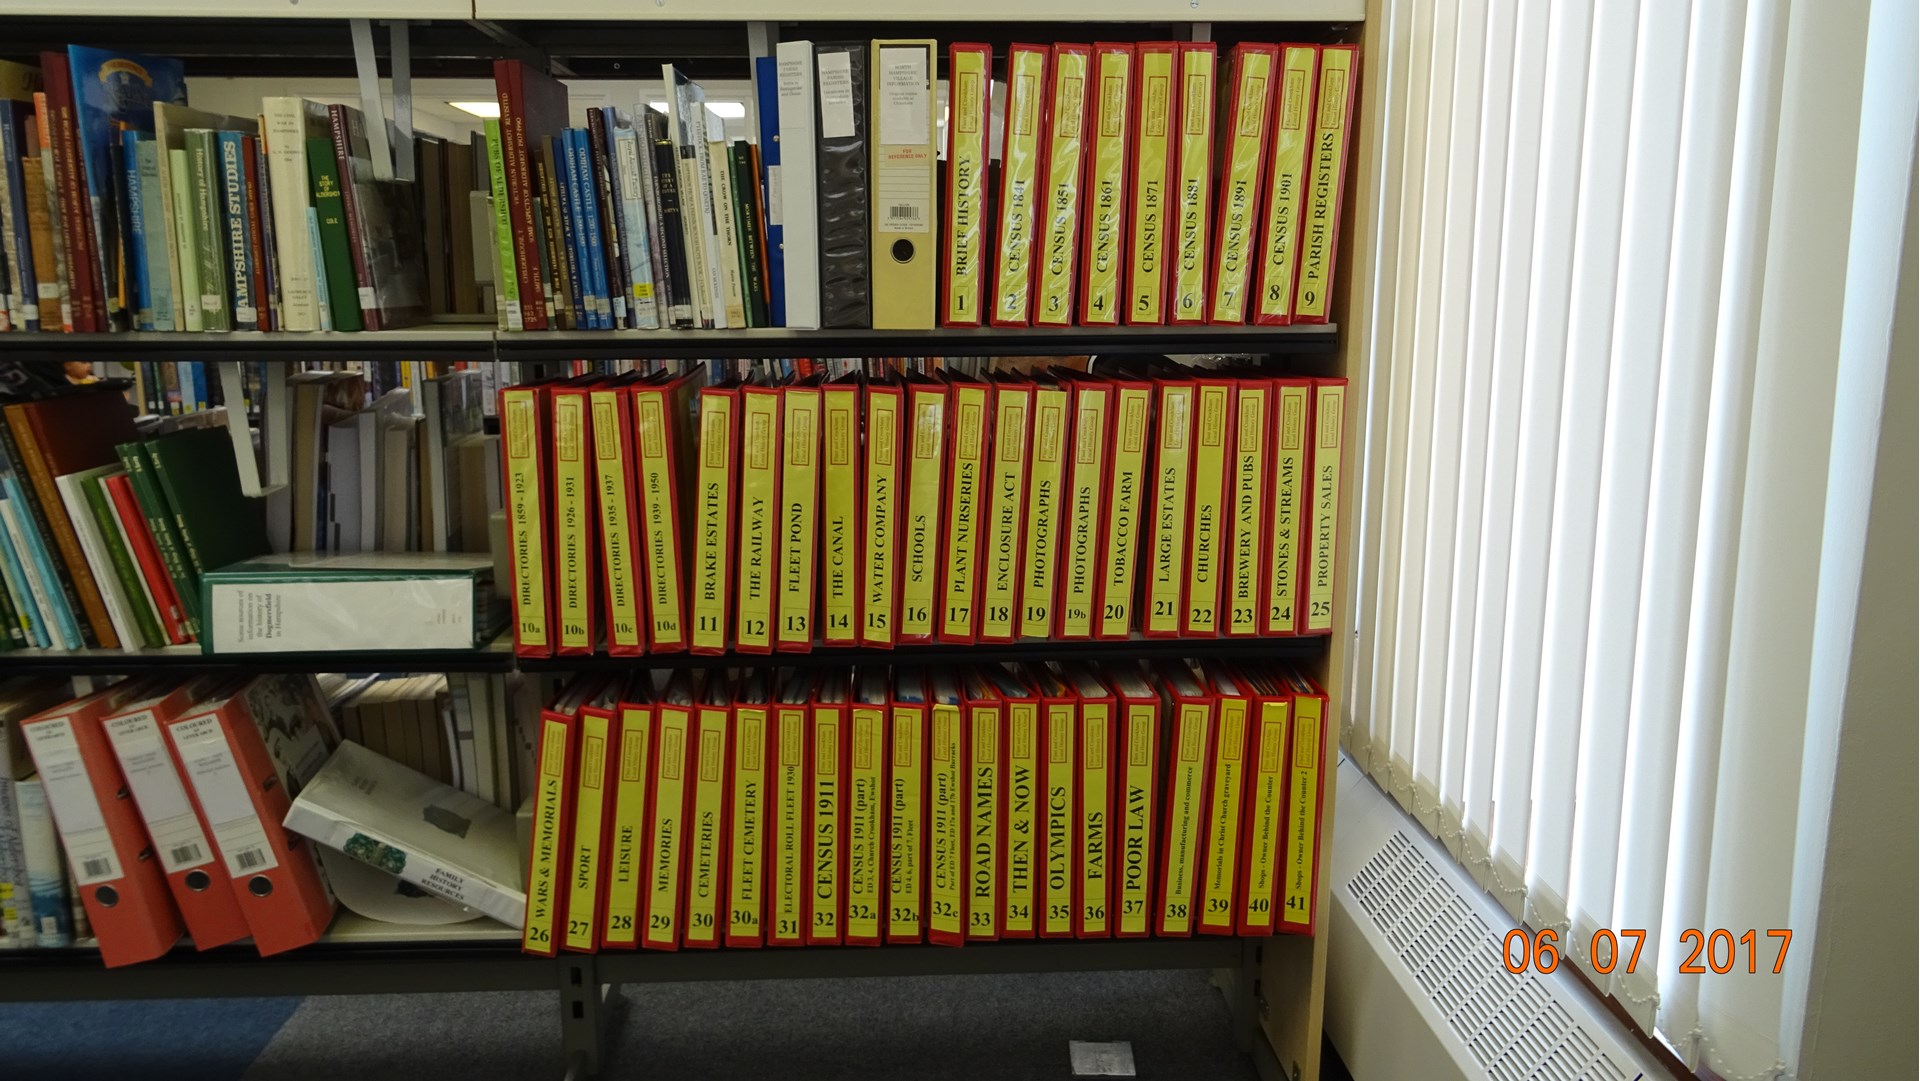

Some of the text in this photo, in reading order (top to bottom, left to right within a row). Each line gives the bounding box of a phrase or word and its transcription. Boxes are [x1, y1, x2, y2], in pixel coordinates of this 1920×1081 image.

[195, 148, 205, 177] History
[331, 110, 345, 160] HAMPSHIRE
[491, 139, 500, 160] PUBS
[494, 162, 502, 173] OF
[502, 93, 520, 205] VICTORIAN ALDERSHOT REVISITED
[518, 150, 529, 187] ALDERSHOT
[127, 170, 142, 235] HAMPSHIRE
[197, 189, 209, 231] Hampshire
[319, 179, 334, 187] STORY
[523, 198, 533, 225] ASPECTS
[579, 148, 597, 247] ODIHAM CASTLE 1200-1500
[723, 202, 728, 211] ON
[744, 203, 752, 231] MORTIMER
[956, 155, 971, 276] BRIEF HISTORY
[1272, 172, 1292, 266] CENSUS 1901
[1307, 132, 1334, 279] PARISH REGISTERS
[224, 141, 251, 308] AMPSHIRE STUDIES
[526, 226, 534, 243] SOME
[747, 235, 755, 259] BETWEEN
[1008, 179, 1025, 272] CENSUS 1841
[1051, 183, 1069, 276] CENSUS 1851
[1096, 179, 1112, 273] CENSUS 1861
[1142, 179, 1158, 273] CENSUS 1871
[1183, 178, 1198, 271] CENSUS 1881
[1226, 179, 1247, 272] CENSUS 1891
[957, 294, 966, 312] 1
[1006, 293, 1017, 311] 2
[1049, 295, 1060, 312] 3
[1138, 294, 1150, 312] 5
[1224, 290, 1235, 308] 7
[1304, 290, 1316, 308] 9
[515, 472, 532, 606] DIRECTORIES 1859 1923
[705, 482, 719, 601] BRAKE ESTATES
[749, 496, 764, 600] THE RAILWAY
[789, 503, 802, 593] FLEET POND
[832, 516, 844, 599] THE CANAL
[872, 474, 888, 603] WATER COMPANY
[912, 514, 926, 583] SCHOOLS
[954, 462, 974, 594] PLANT NURSERIES
[997, 471, 1016, 592] ENCLOSURE ACT
[1033, 479, 1051, 589] PHOTOGRAPHS
[1113, 470, 1133, 587] TOBACCO FARM
[1159, 467, 1176, 583] LARGE ESTATES
[1197, 504, 1212, 583] CHURCHES
[1238, 455, 1255, 599] BREWERY AND PUBS
[1276, 456, 1294, 598] STONES & STREAMS
[1317, 465, 1333, 587] PROPERTY SALES
[264, 593, 273, 639] Dogmersfield
[521, 621, 541, 635] 10a
[868, 612, 886, 630] 15
[1067, 608, 1087, 622] 19b
[1298, 805, 1306, 817] the
[1299, 776, 1308, 804] Counter
[536, 779, 557, 919] WARS & MEMORIALS
[619, 825, 633, 883] LEISURE
[659, 818, 673, 892] MEMORIES
[698, 810, 713, 898] CEMETERIES
[743, 779, 757, 901] FLEET CEMETERY
[784, 765, 795, 913] ELECTORAL ROLL FLEET 1930
[817, 780, 834, 900] CENSUS 1911
[974, 766, 993, 898] ROAD NAMES
[1012, 764, 1031, 894] THEN & NOW
[1051, 786, 1066, 891] OLYMPICS
[1088, 810, 1104, 880] FARMS
[1126, 784, 1145, 892] POOR LAW
[1174, 766, 1194, 895] Business, manufacturing and commerce
[1296, 843, 1305, 864] Owner
[1297, 818, 1306, 841] Behind
[420, 878, 465, 901] RESOURCES
[429, 873, 463, 892] HISTORY
[434, 867, 464, 885] FAMILY
[578, 844, 591, 890] SPORT
[1286, 895, 1305, 912] 41
[1295, 870, 1304, 890] Shops
[530, 926, 549, 943] 26
